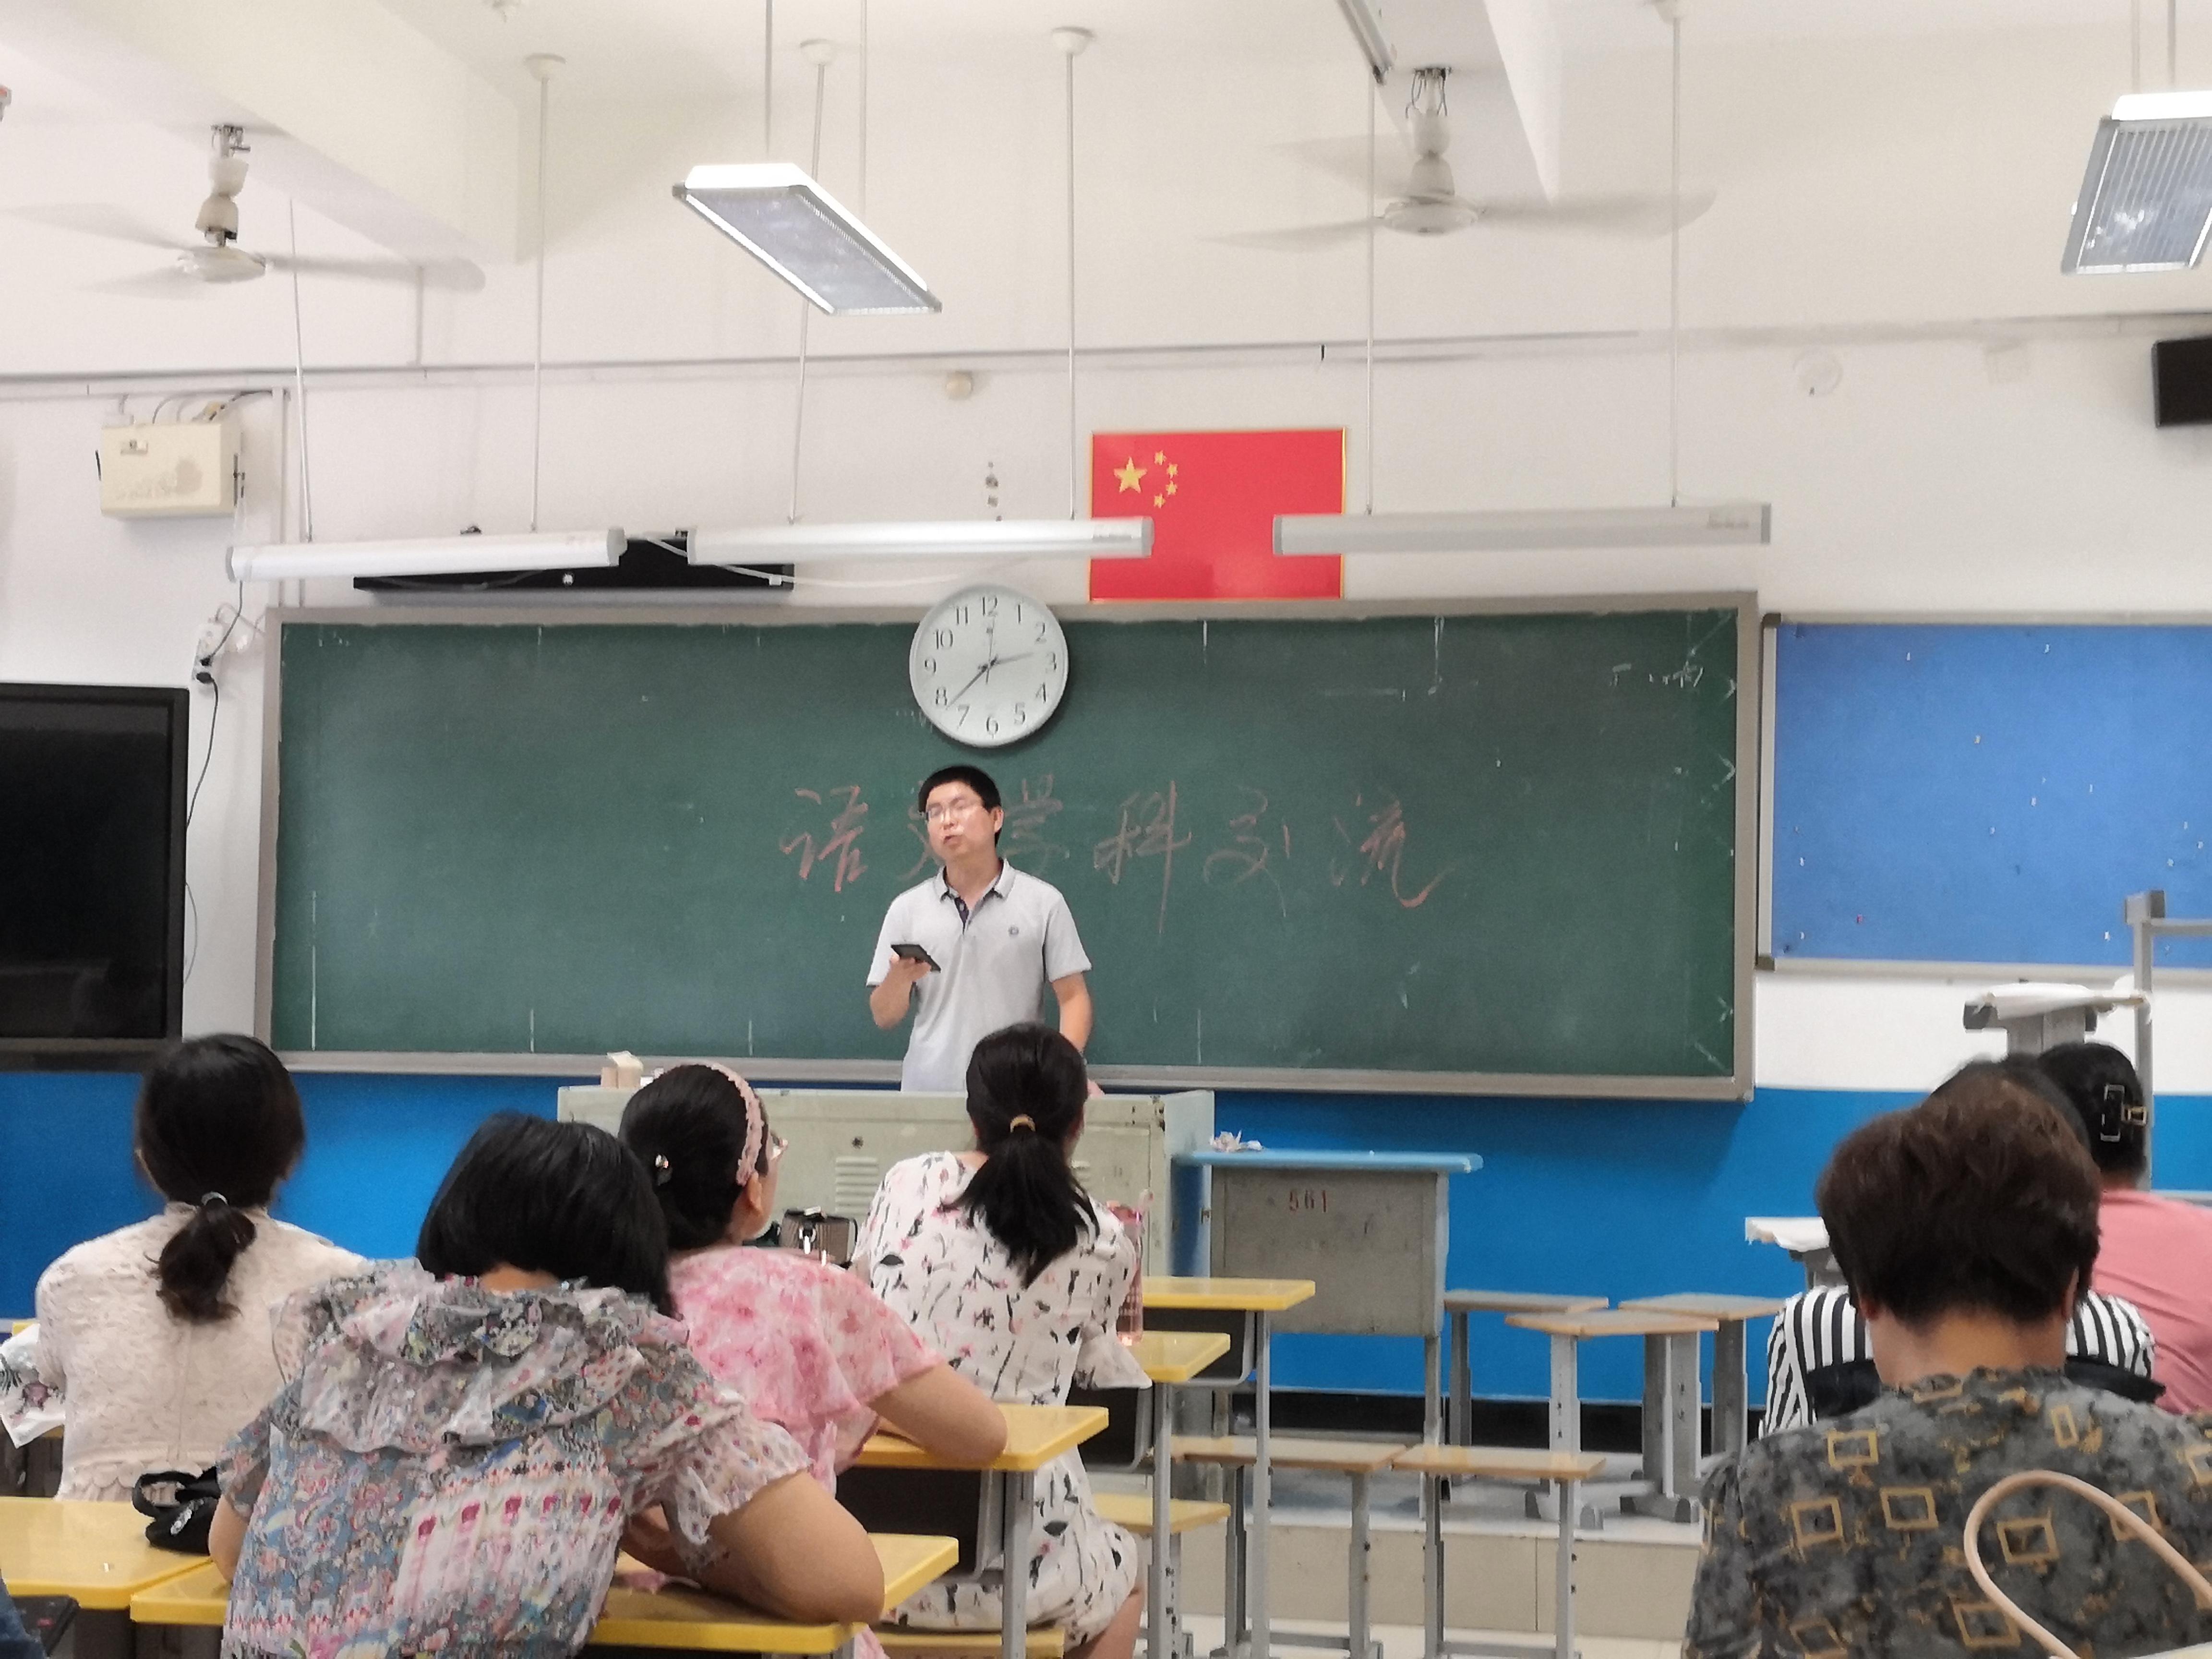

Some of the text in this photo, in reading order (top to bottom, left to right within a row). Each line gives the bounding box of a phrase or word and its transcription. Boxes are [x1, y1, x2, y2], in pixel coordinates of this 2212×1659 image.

[953, 605, 969, 625] 11
[980, 596, 998, 617] 12
[933, 628, 954, 649] 10
[1035, 622, 1047, 644] 2
[924, 657, 937, 674] 9
[1045, 651, 1057, 673] 3
[935, 686, 948, 705] 8
[1035, 682, 1047, 704] 4
[957, 703, 970, 728] 7
[1014, 701, 1026, 725] 5
[986, 715, 999, 736] 6
[1289, 1190, 1327, 1213] 561
